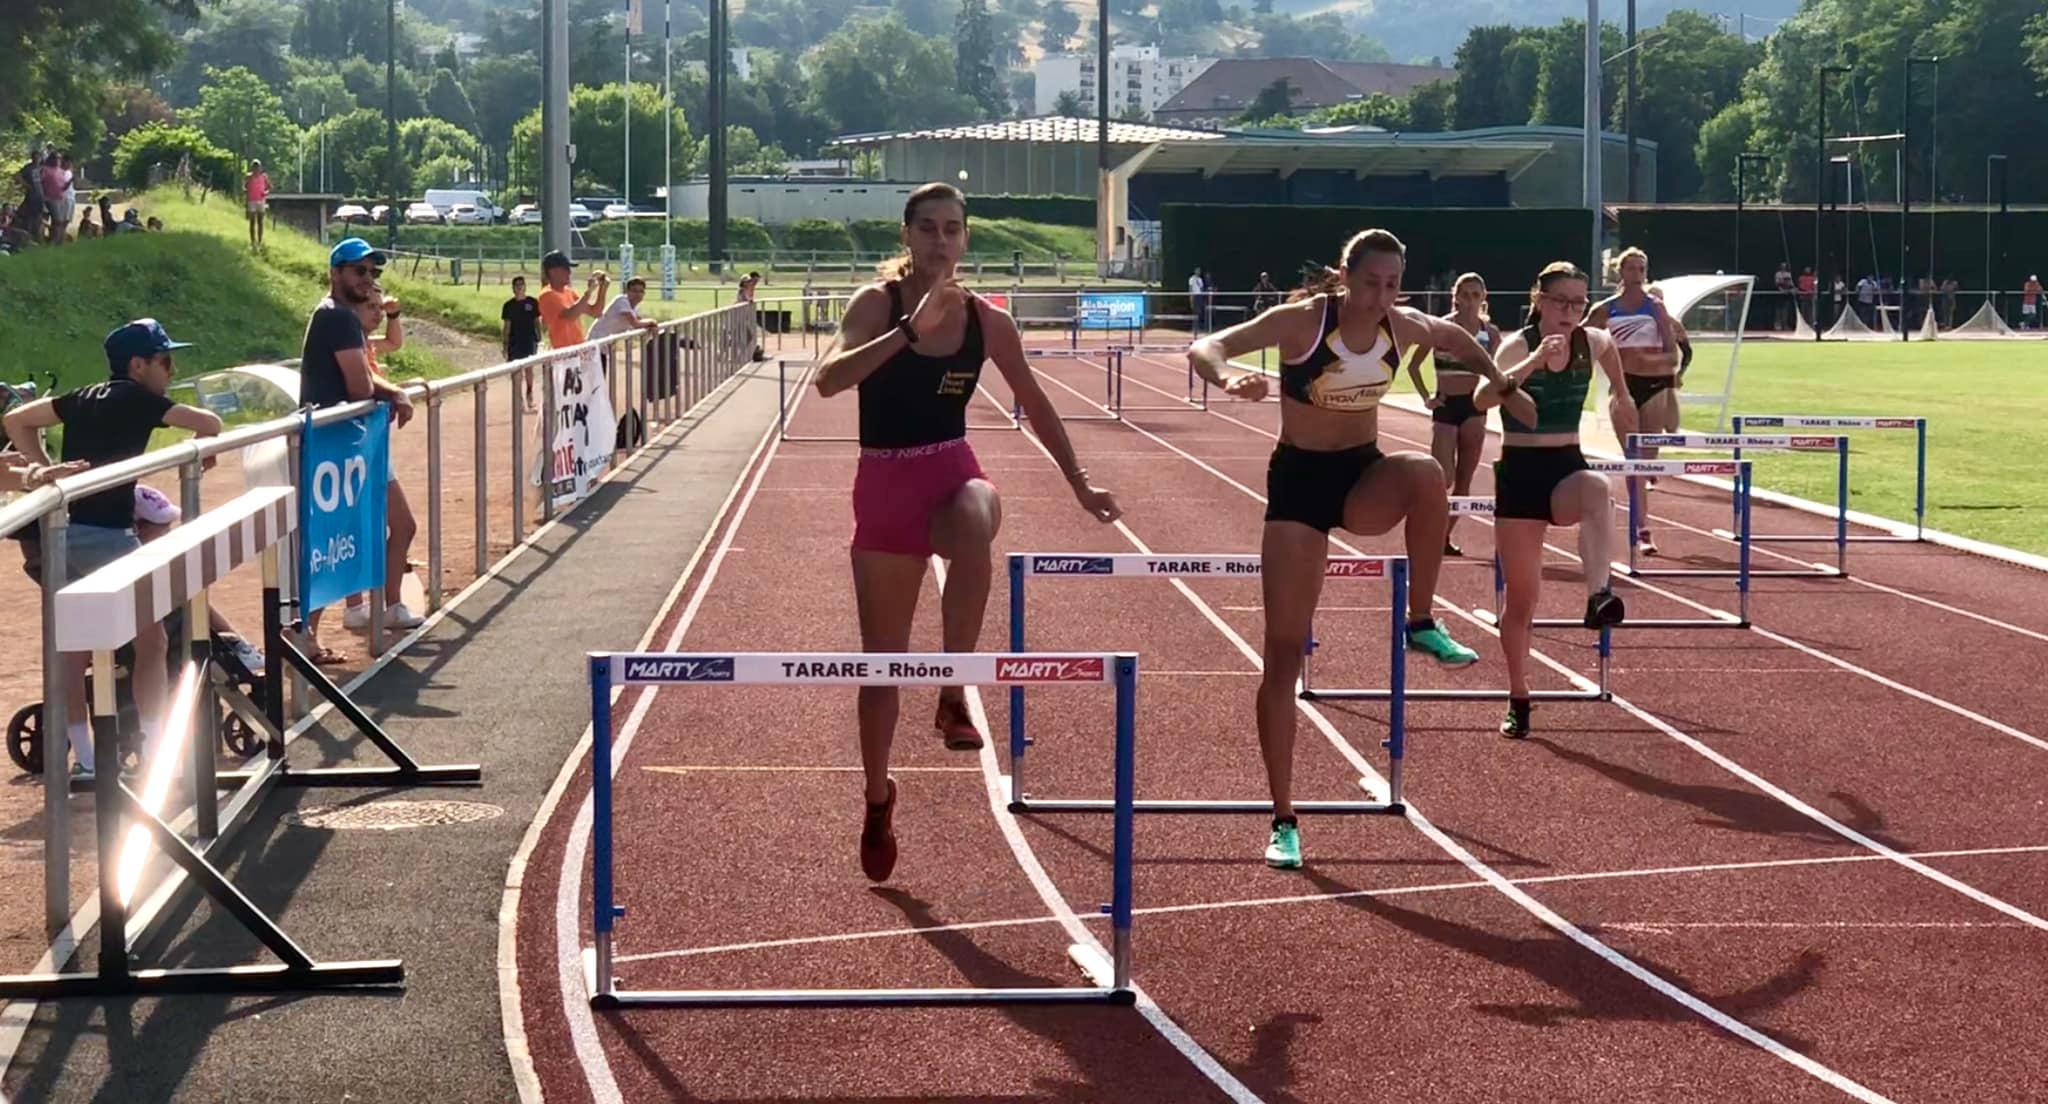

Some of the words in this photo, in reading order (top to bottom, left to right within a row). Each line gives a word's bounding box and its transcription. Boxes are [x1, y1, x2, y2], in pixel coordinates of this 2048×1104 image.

[1704, 437, 1739, 445] TARARE
[1747, 437, 1774, 445] Rhône
[896, 443, 938, 458] NIKE
[1633, 463, 1665, 472] Rhône
[1686, 463, 1720, 473] MARTY
[1470, 501, 1496, 511] Rhô
[1035, 559, 1088, 572] MARTY
[1147, 561, 1211, 573] TARARE
[1226, 561, 1262, 573] Rhôn
[1326, 562, 1358, 574] RTY
[628, 662, 699, 678] MARTY
[782, 662, 869, 677] TARARE
[889, 661, 954, 677] Rhône
[999, 662, 1069, 678] MARTY
